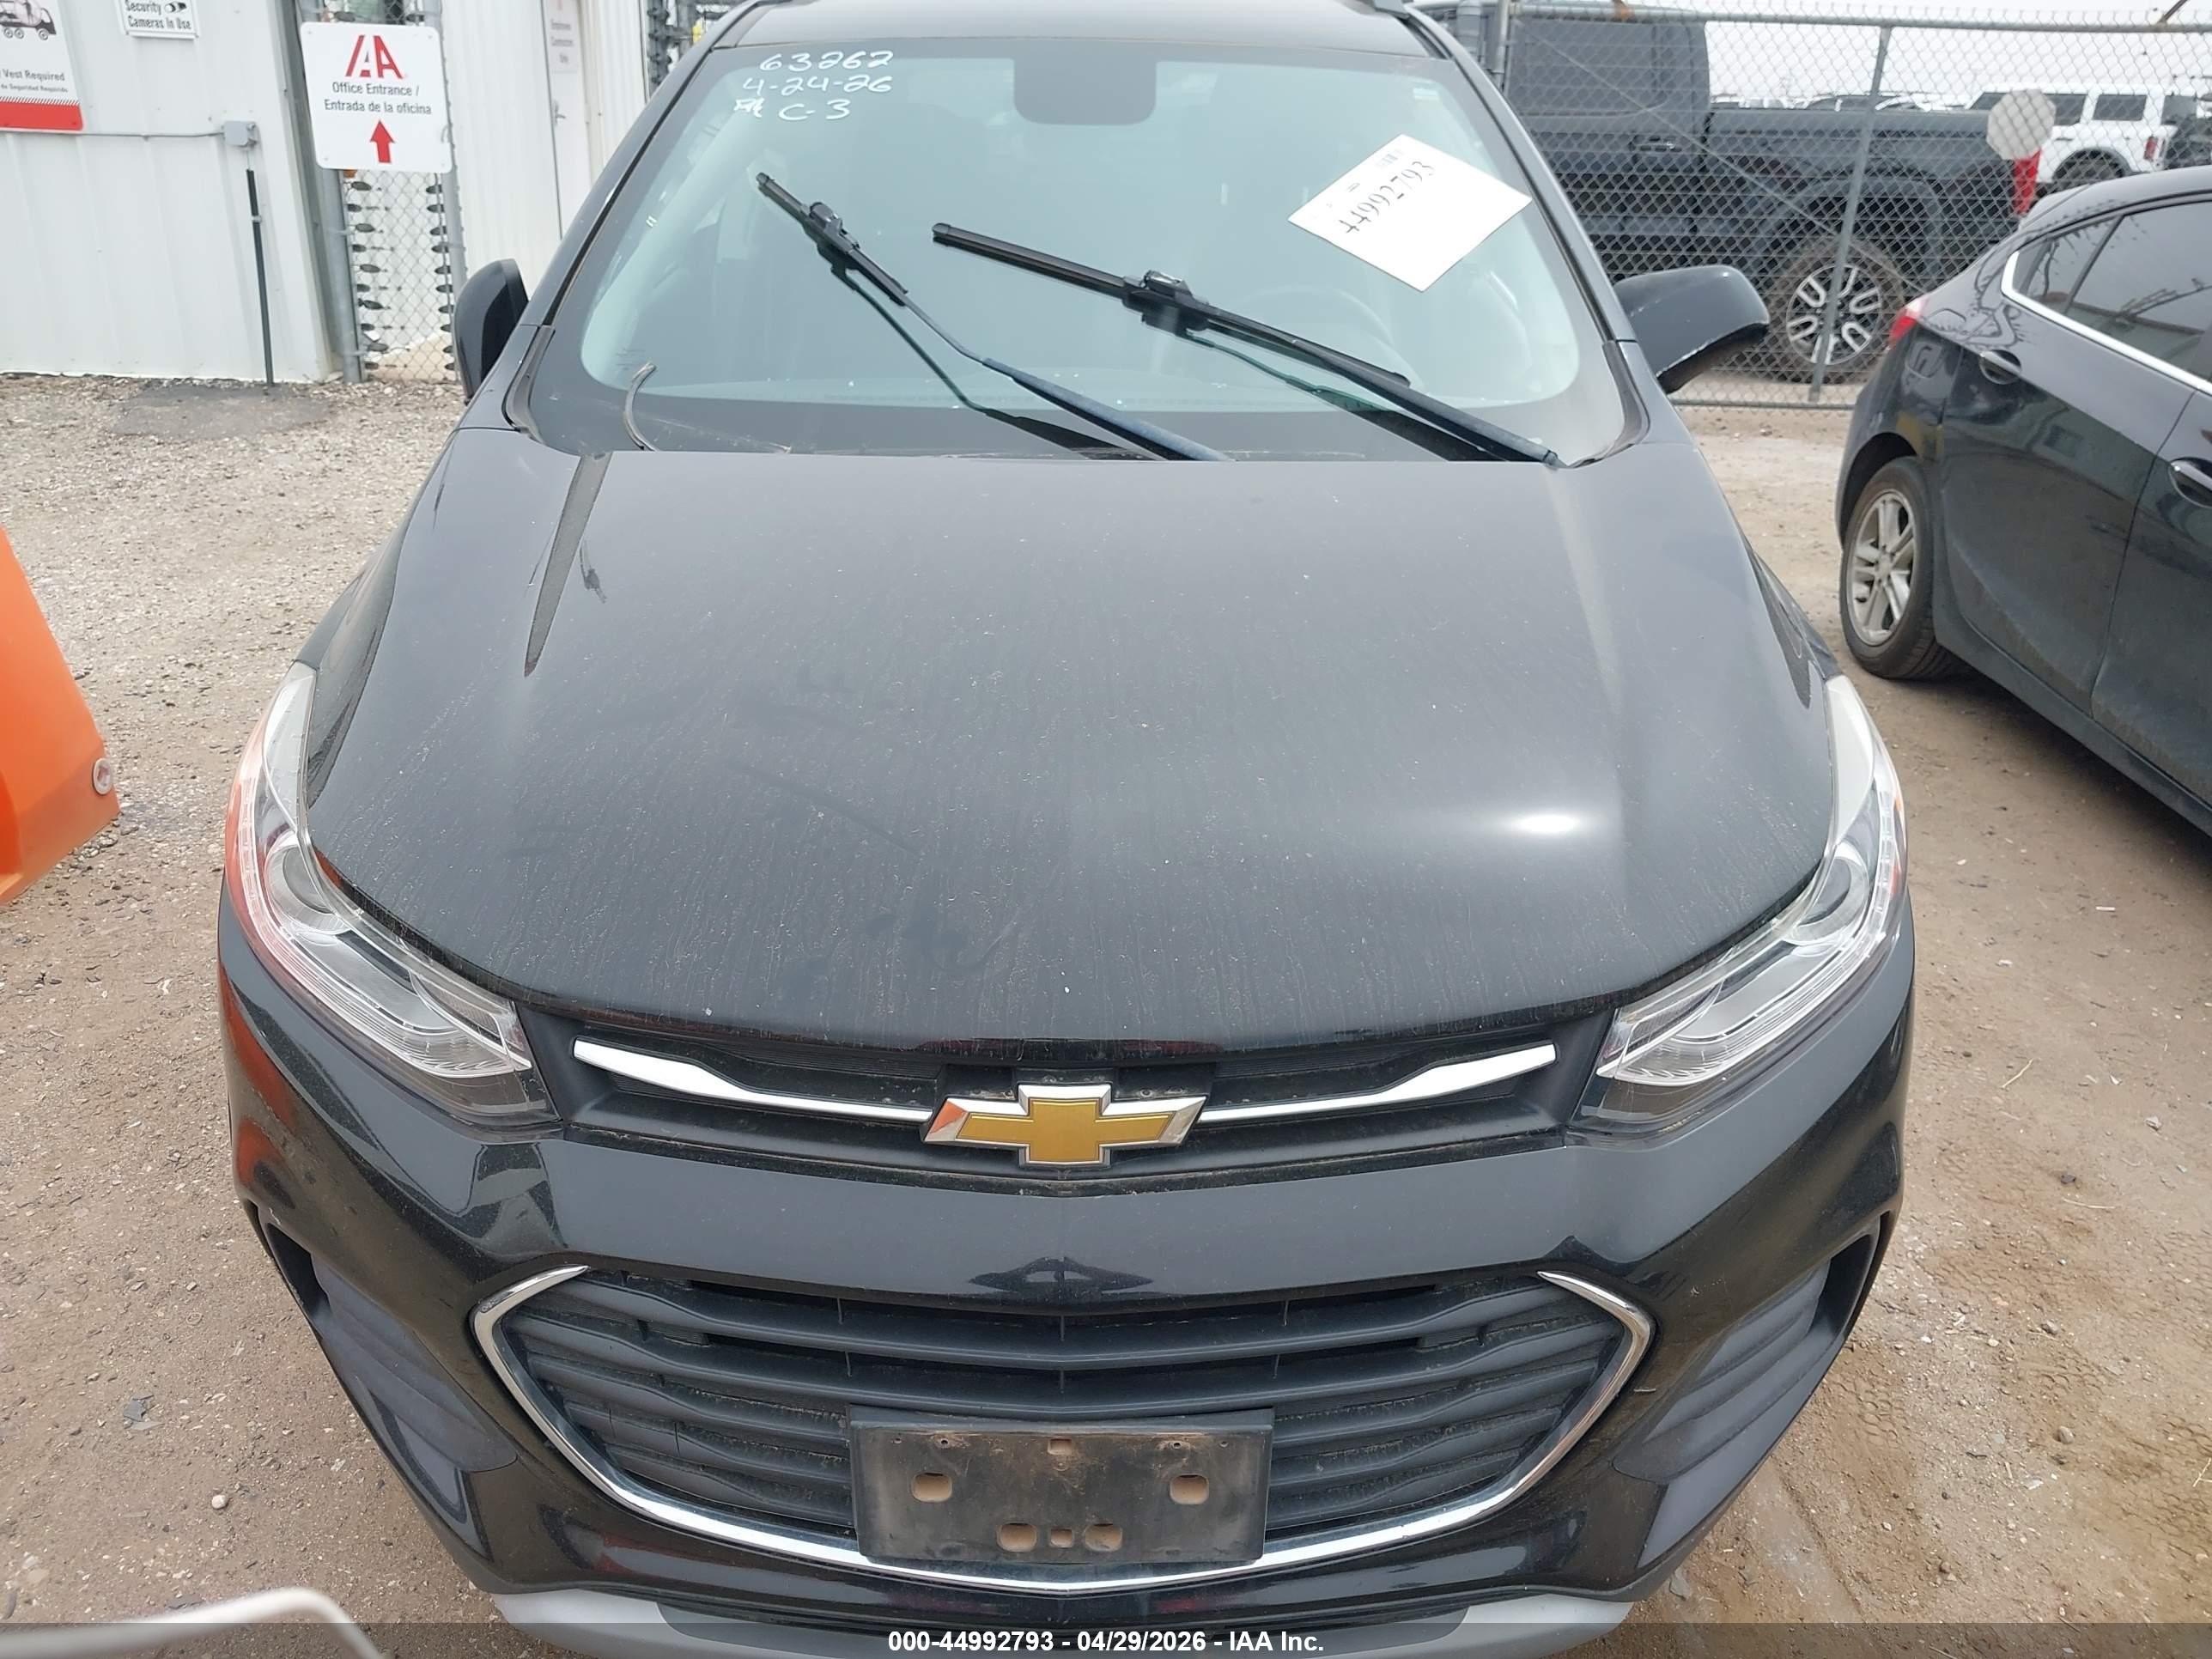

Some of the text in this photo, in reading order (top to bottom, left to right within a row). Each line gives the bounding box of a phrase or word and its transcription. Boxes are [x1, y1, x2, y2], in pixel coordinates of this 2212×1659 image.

[125, 0, 161, 15] Security
[128, 15, 164, 28] Cameras
[176, 17, 191, 29] Use
[760, 50, 894, 71] 63262
[3, 69, 65, 82] Vest Required
[332, 82, 363, 94] Office
[367, 83, 412, 96] Entrance
[743, 74, 893, 95] 4-24-26
[325, 99, 432, 115] Entrada de la oficina
[1339, 161, 1435, 233] 44992793
